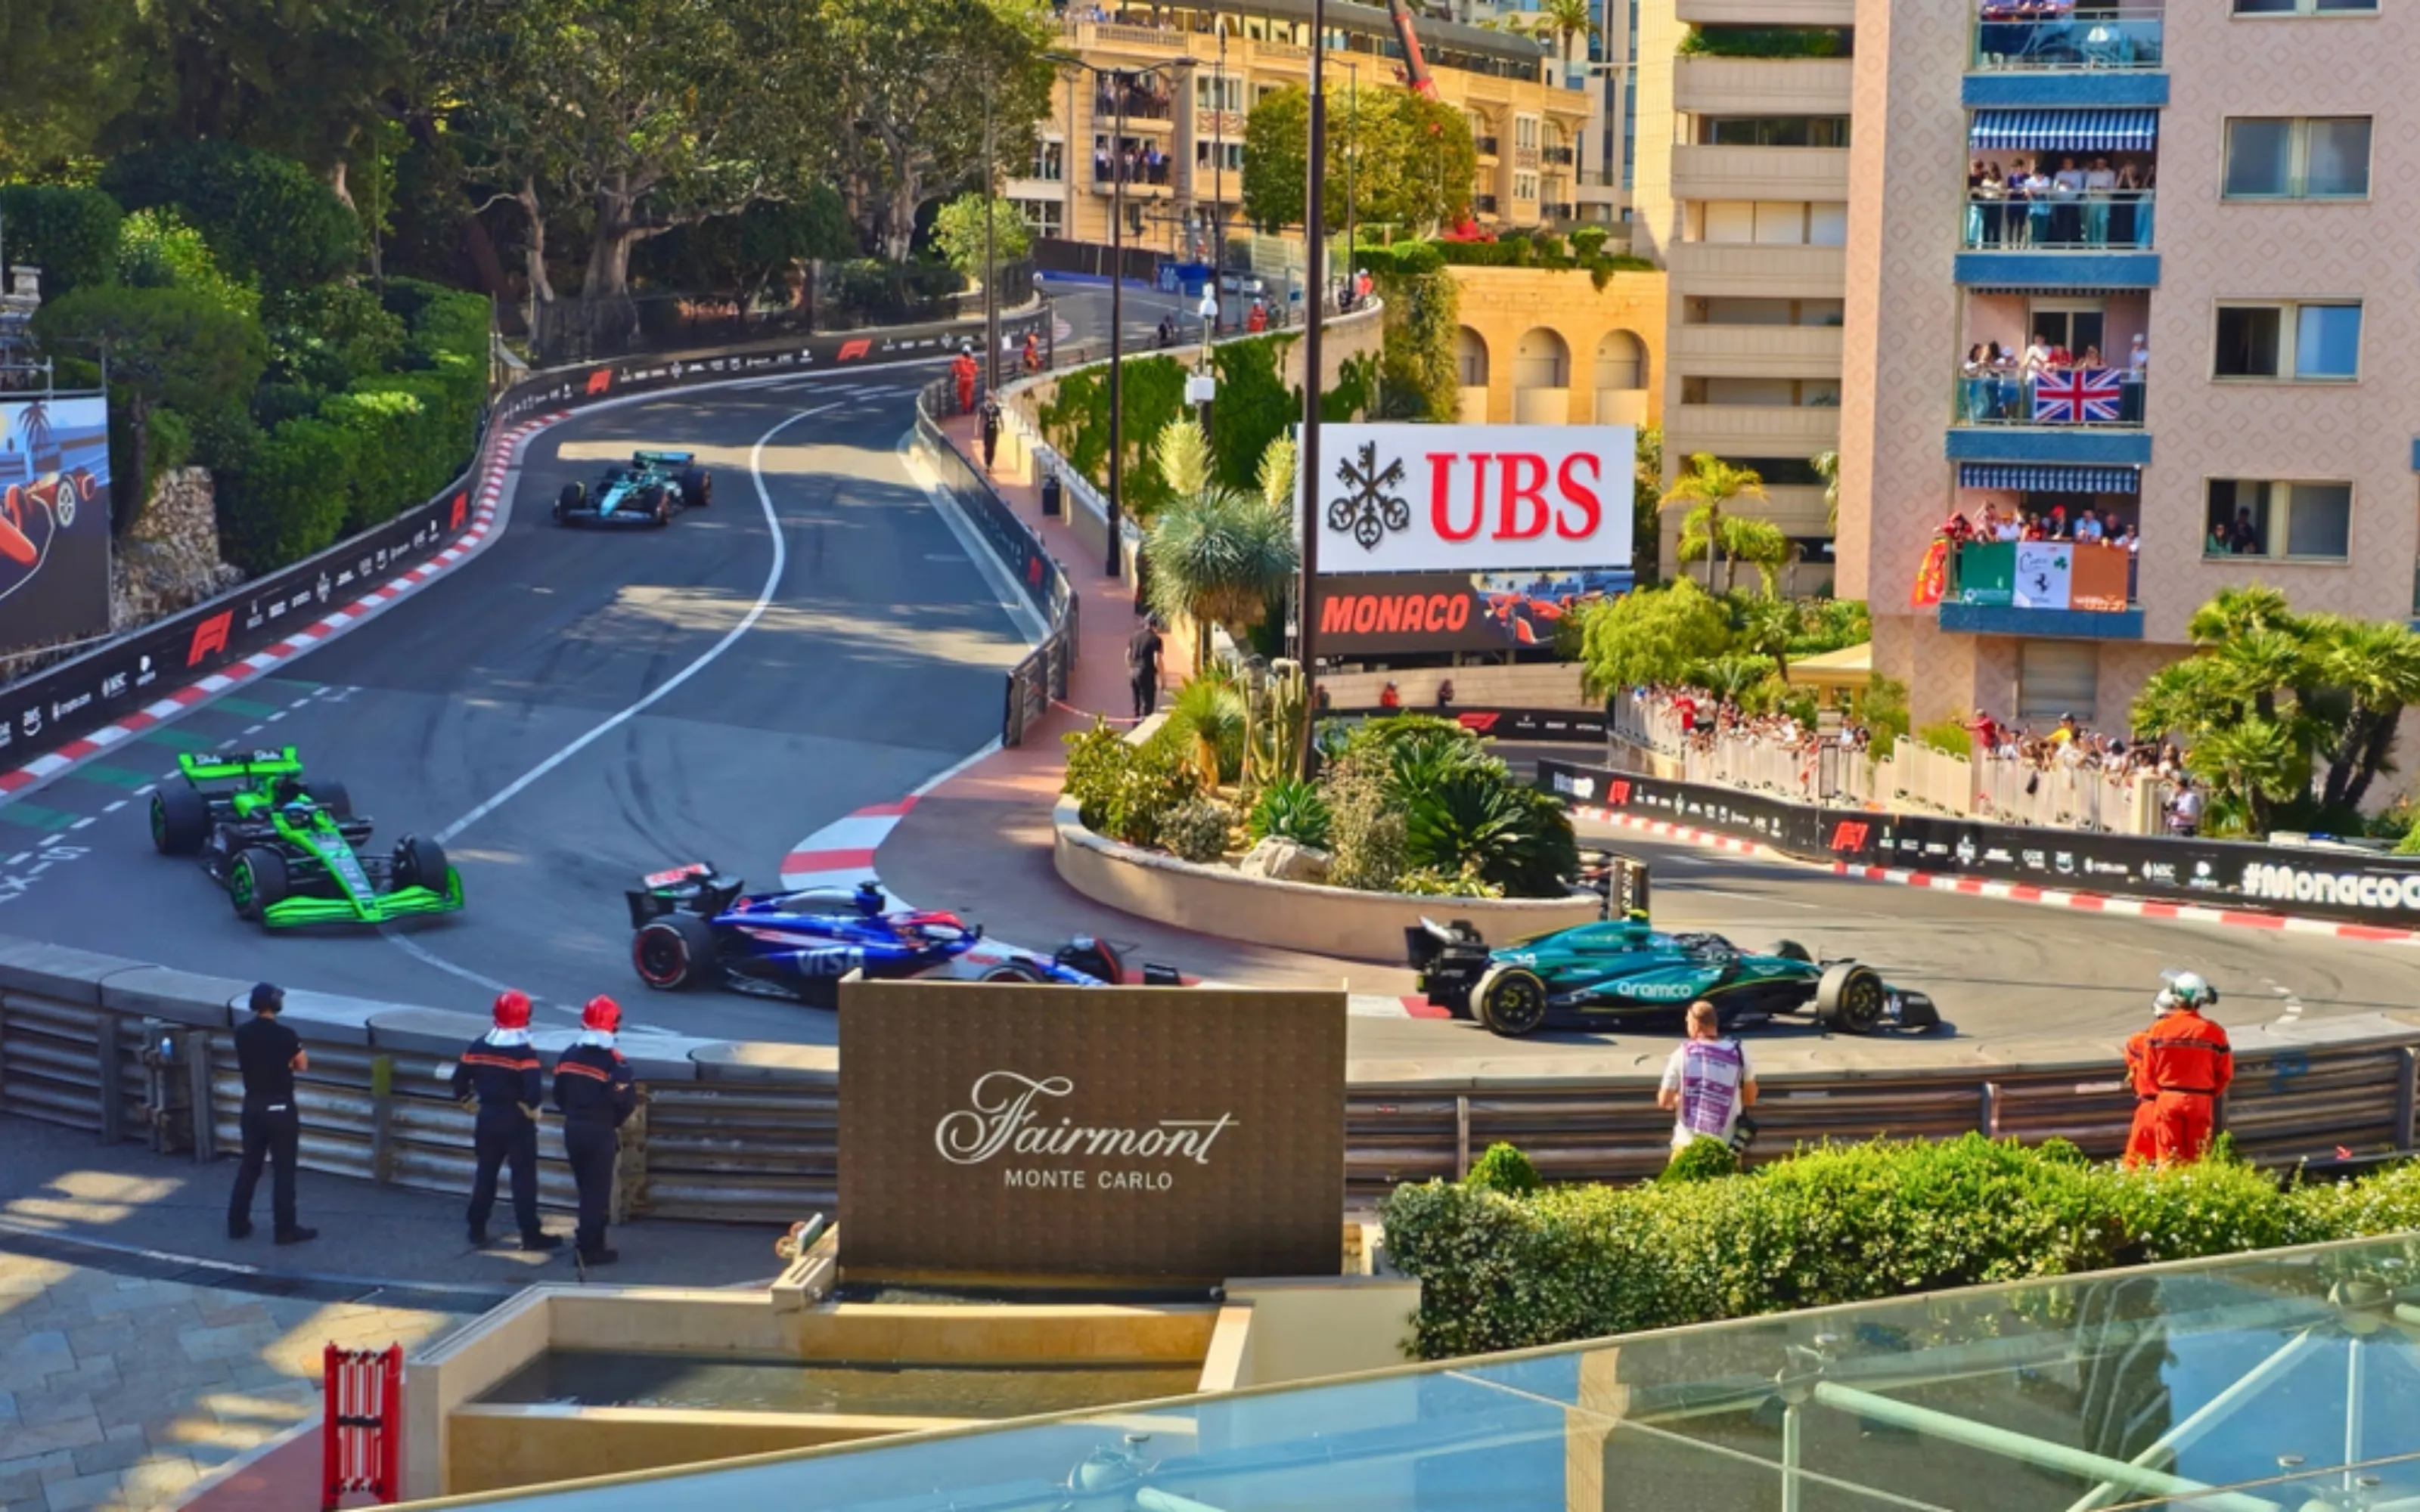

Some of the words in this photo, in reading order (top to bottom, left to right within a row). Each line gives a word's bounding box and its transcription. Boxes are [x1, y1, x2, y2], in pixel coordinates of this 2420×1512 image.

[1426, 451, 1602, 542] UBS
[1320, 592, 1470, 634] MONACO
[796, 946, 864, 977] VISA
[1617, 981, 1693, 999] aramco
[935, 1070, 1240, 1165] Fairmont
[1004, 1169, 1085, 1189] MONTE
[1097, 1170, 1173, 1191] CARLO
